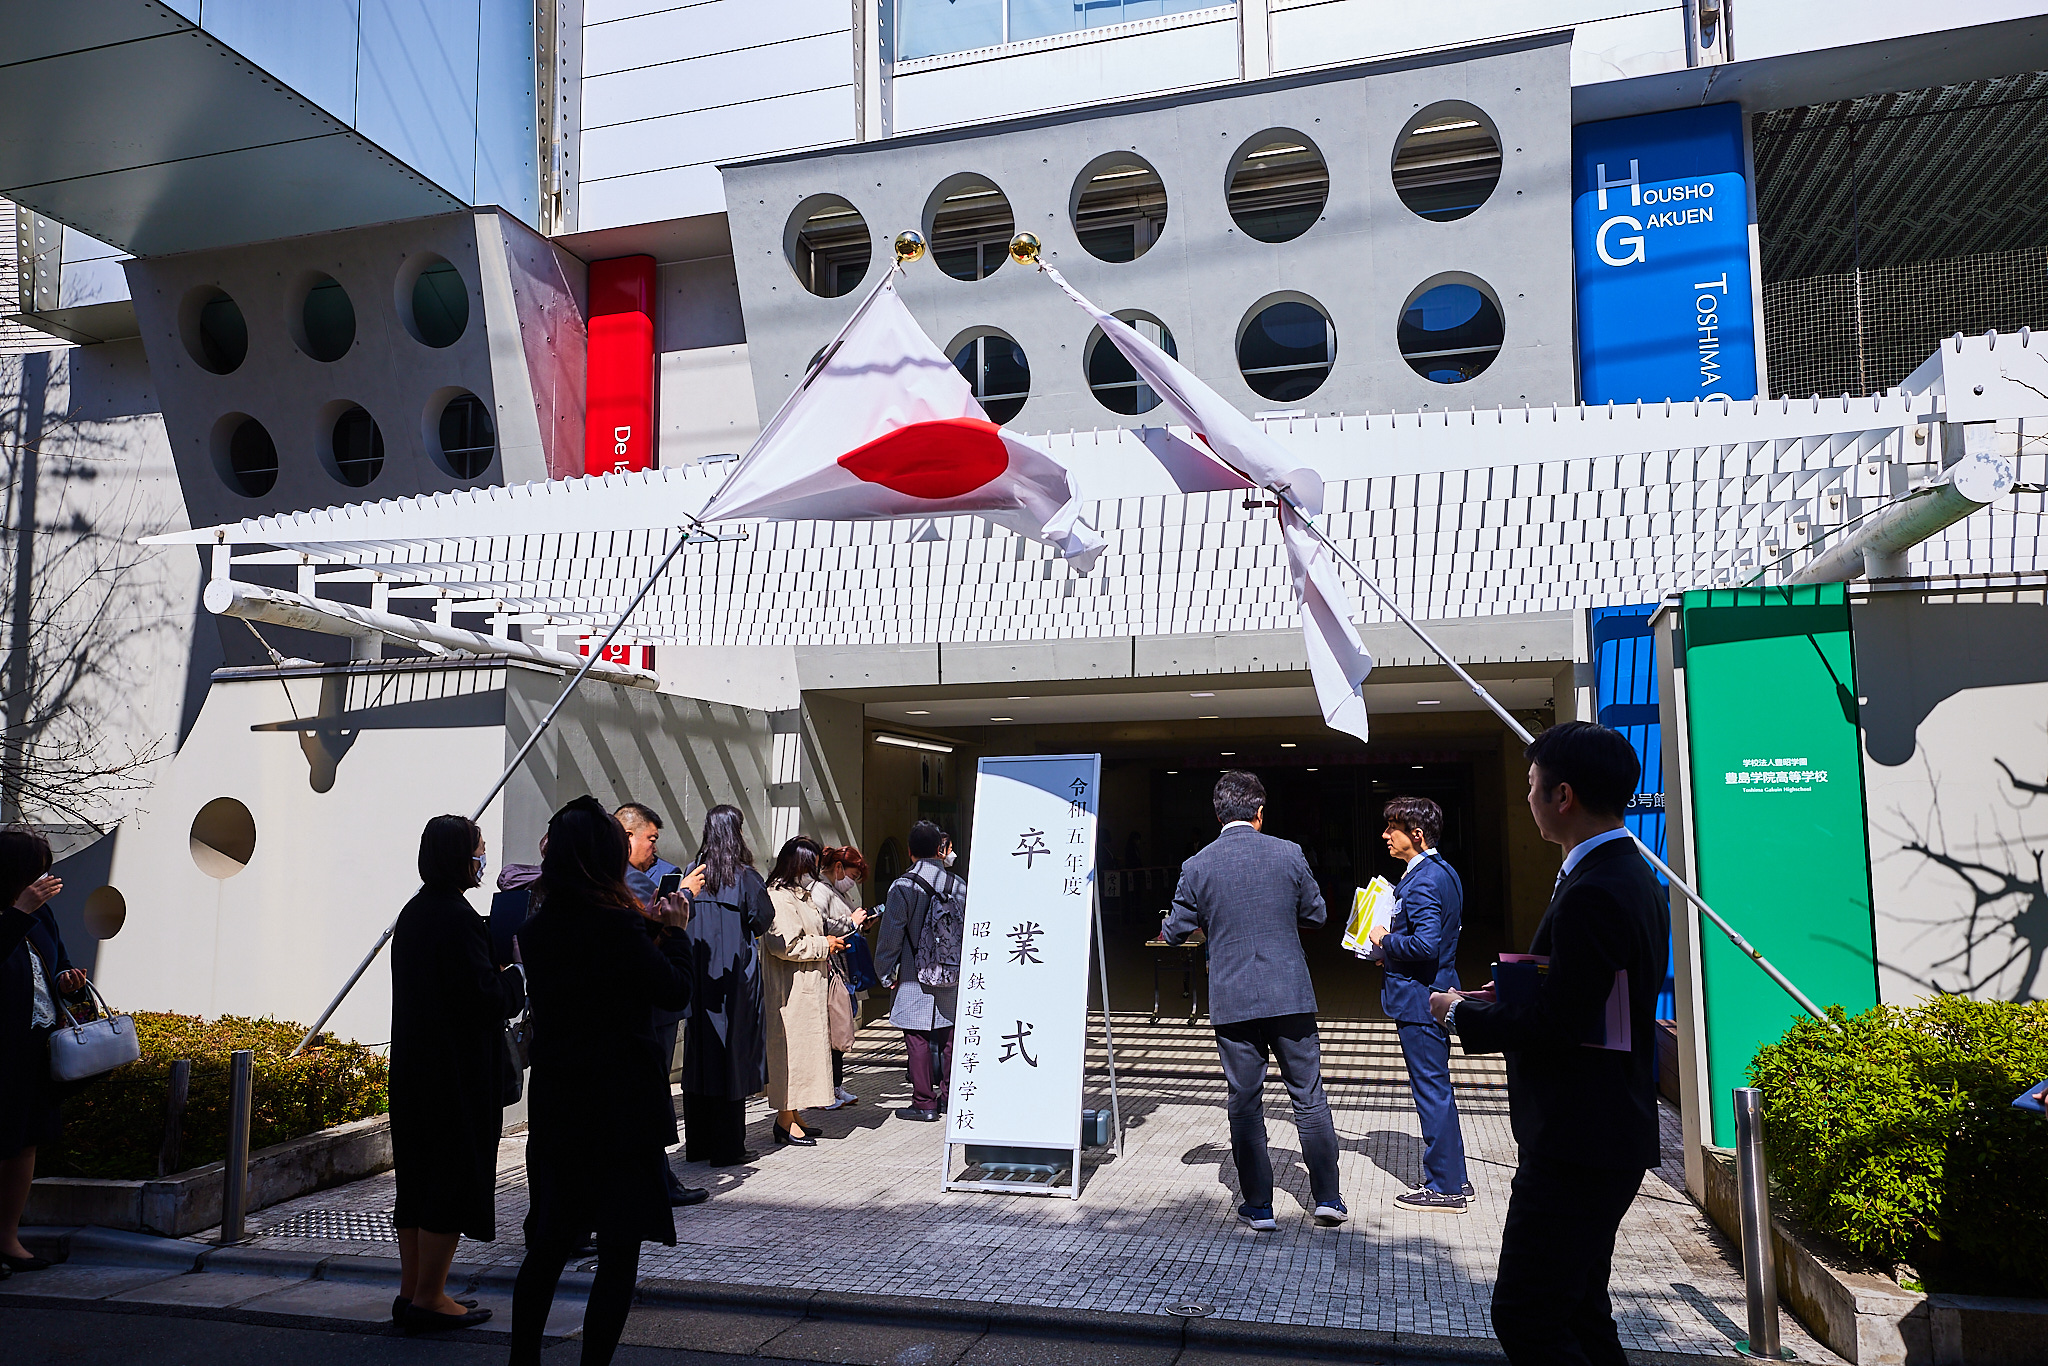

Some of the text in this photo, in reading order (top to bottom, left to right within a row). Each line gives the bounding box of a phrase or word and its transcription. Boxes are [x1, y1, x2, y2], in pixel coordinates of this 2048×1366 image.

[1596, 158, 1714, 211] HOUSHO
[1596, 206, 1714, 267] GAKUEN
[1694, 272, 1728, 387] TOSHIMA
[614, 425, 631, 455] De
[1725, 769, 1829, 784] 豊島学院高等学校
[1062, 777, 1088, 897] 令和五年度
[997, 827, 1051, 1068] 卒業式
[955, 921, 991, 1131] 昭和鉄道高等学校
